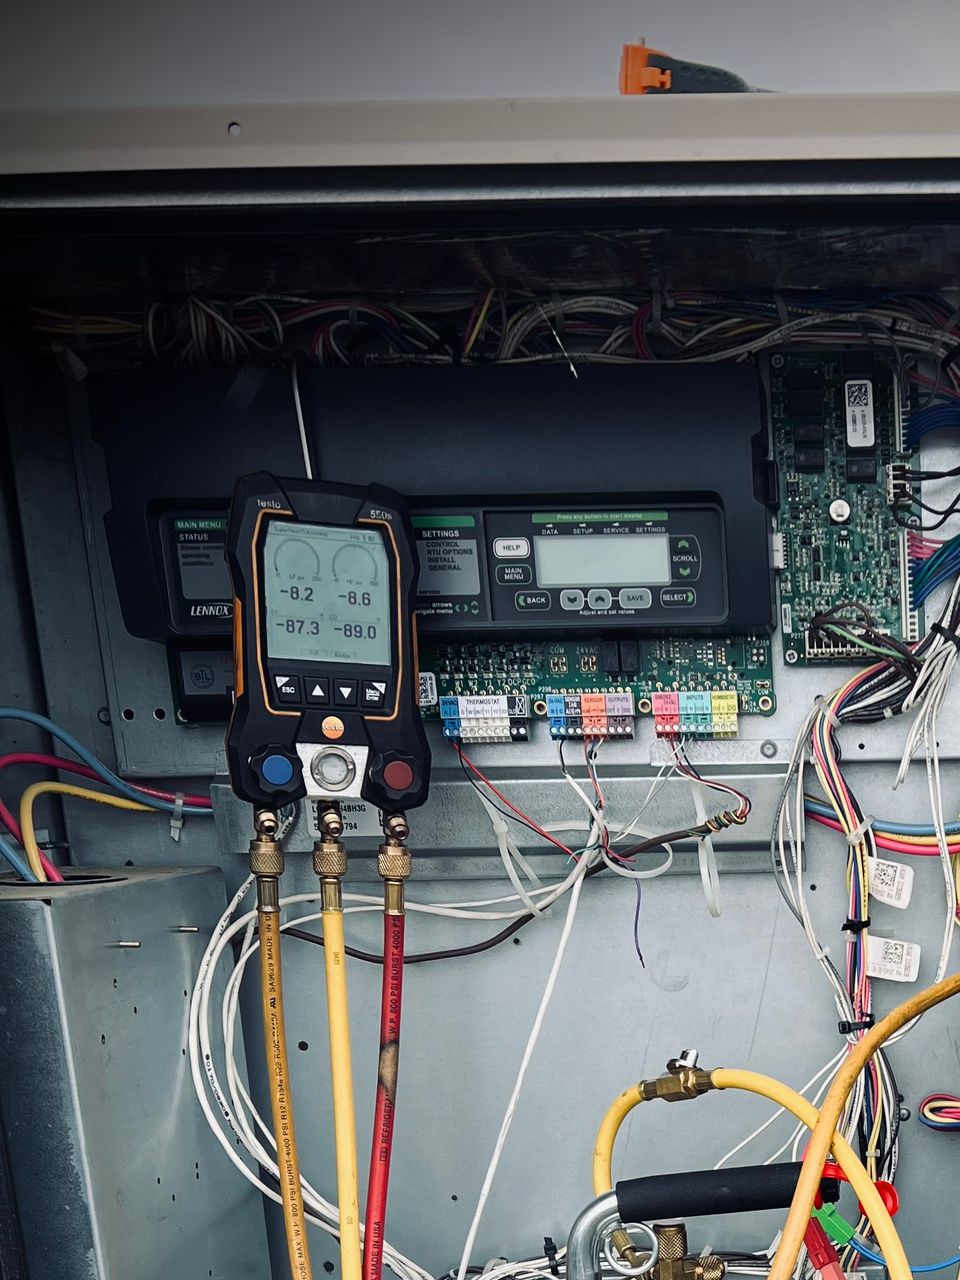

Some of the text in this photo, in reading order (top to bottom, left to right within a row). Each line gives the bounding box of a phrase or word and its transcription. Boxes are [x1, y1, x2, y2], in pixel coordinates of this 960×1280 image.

[257, 499, 281, 509] testo
[370, 509, 393, 520] 550s
[177, 521, 222, 529] MAIN MENU
[422, 530, 459, 538] SETTINGS
[442, 548, 473, 556] OPTIONS
[280, 585, 314, 602] -8.2
[338, 591, 371, 606] -8.6
[190, 605, 229, 616] LENNOX
[276, 619, 320, 635] -87.3
[334, 623, 377, 640] -89.0
[550, 646, 565, 654] COM
[576, 646, 599, 655] 24VAC
[281, 686, 295, 694] ESC
[265, 923, 272, 932] IN
[391, 951, 399, 981] BURST
[389, 1000, 398, 1013] 800
[373, 1221, 382, 1240] USA
[373, 1241, 380, 1250] IN
